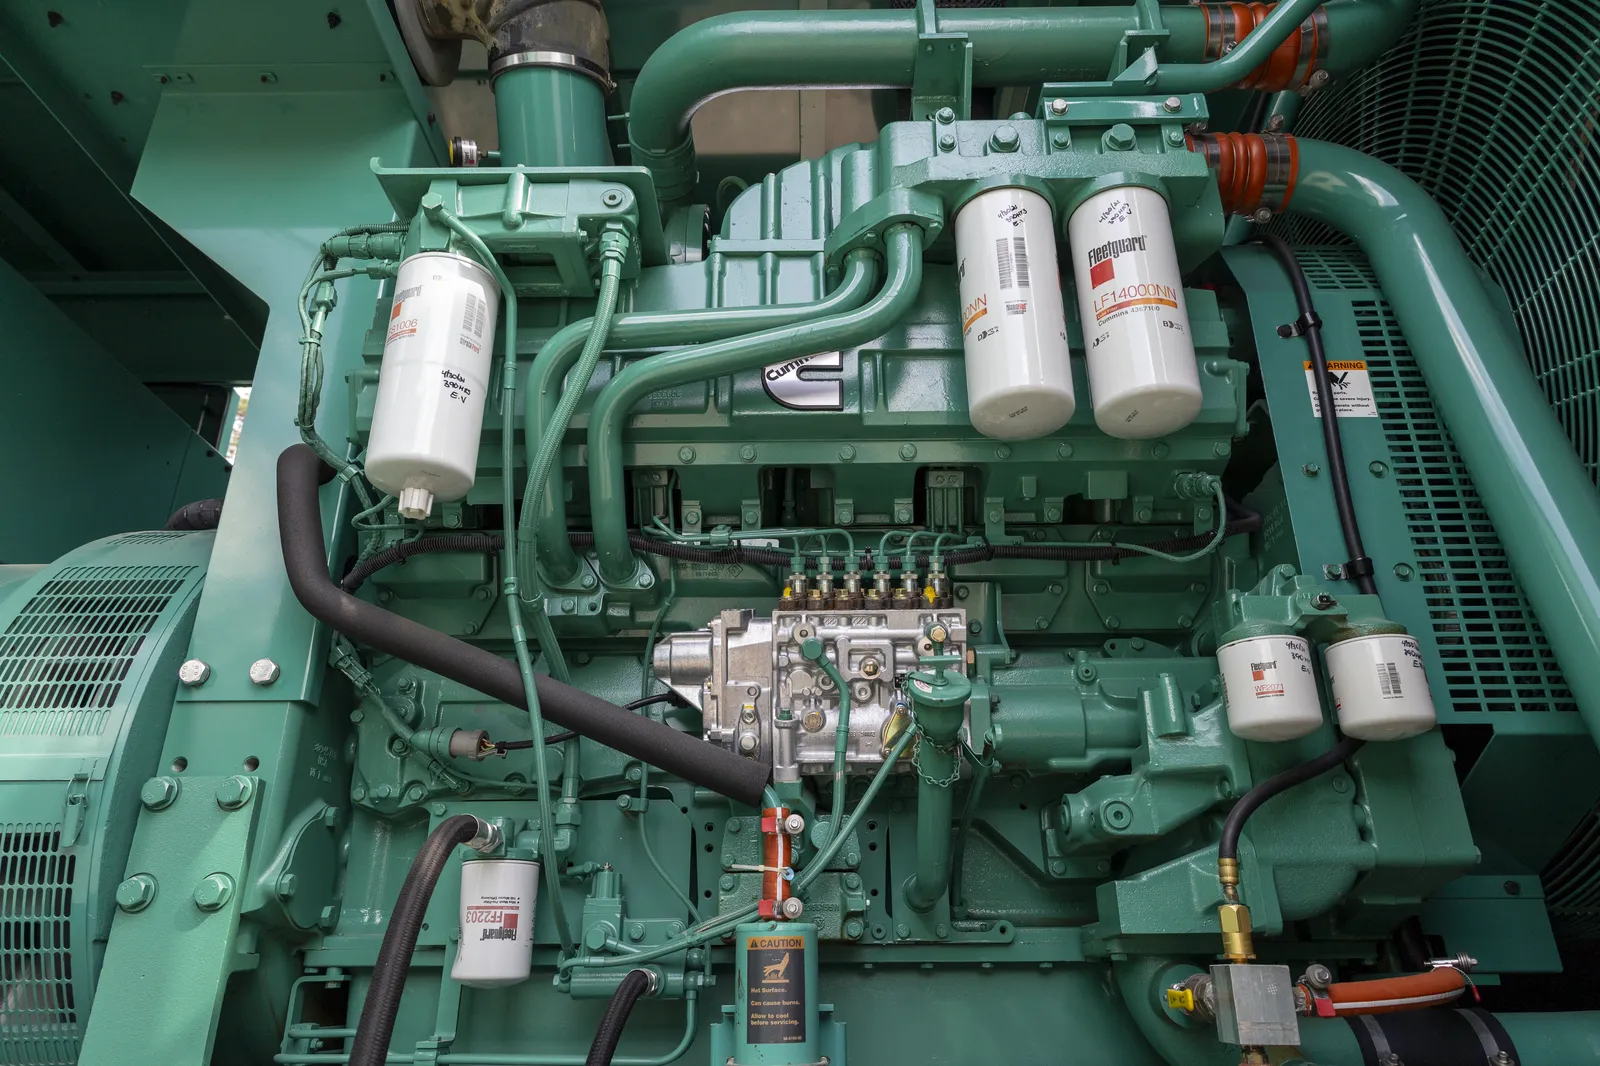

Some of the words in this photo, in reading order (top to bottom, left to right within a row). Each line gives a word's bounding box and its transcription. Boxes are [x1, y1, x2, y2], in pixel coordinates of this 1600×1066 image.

[1088, 235, 1147, 268] Fleetguard
[1093, 283, 1178, 313] LF14000NN
[1098, 309, 1129, 327] Cummins
[1250, 660, 1277, 672] Fleetguard
[465, 911, 503, 923] FF2203
[480, 926, 517, 941] Fleetguard
[760, 939, 802, 948] CAUTION
[770, 1018, 799, 1026] servicing.
